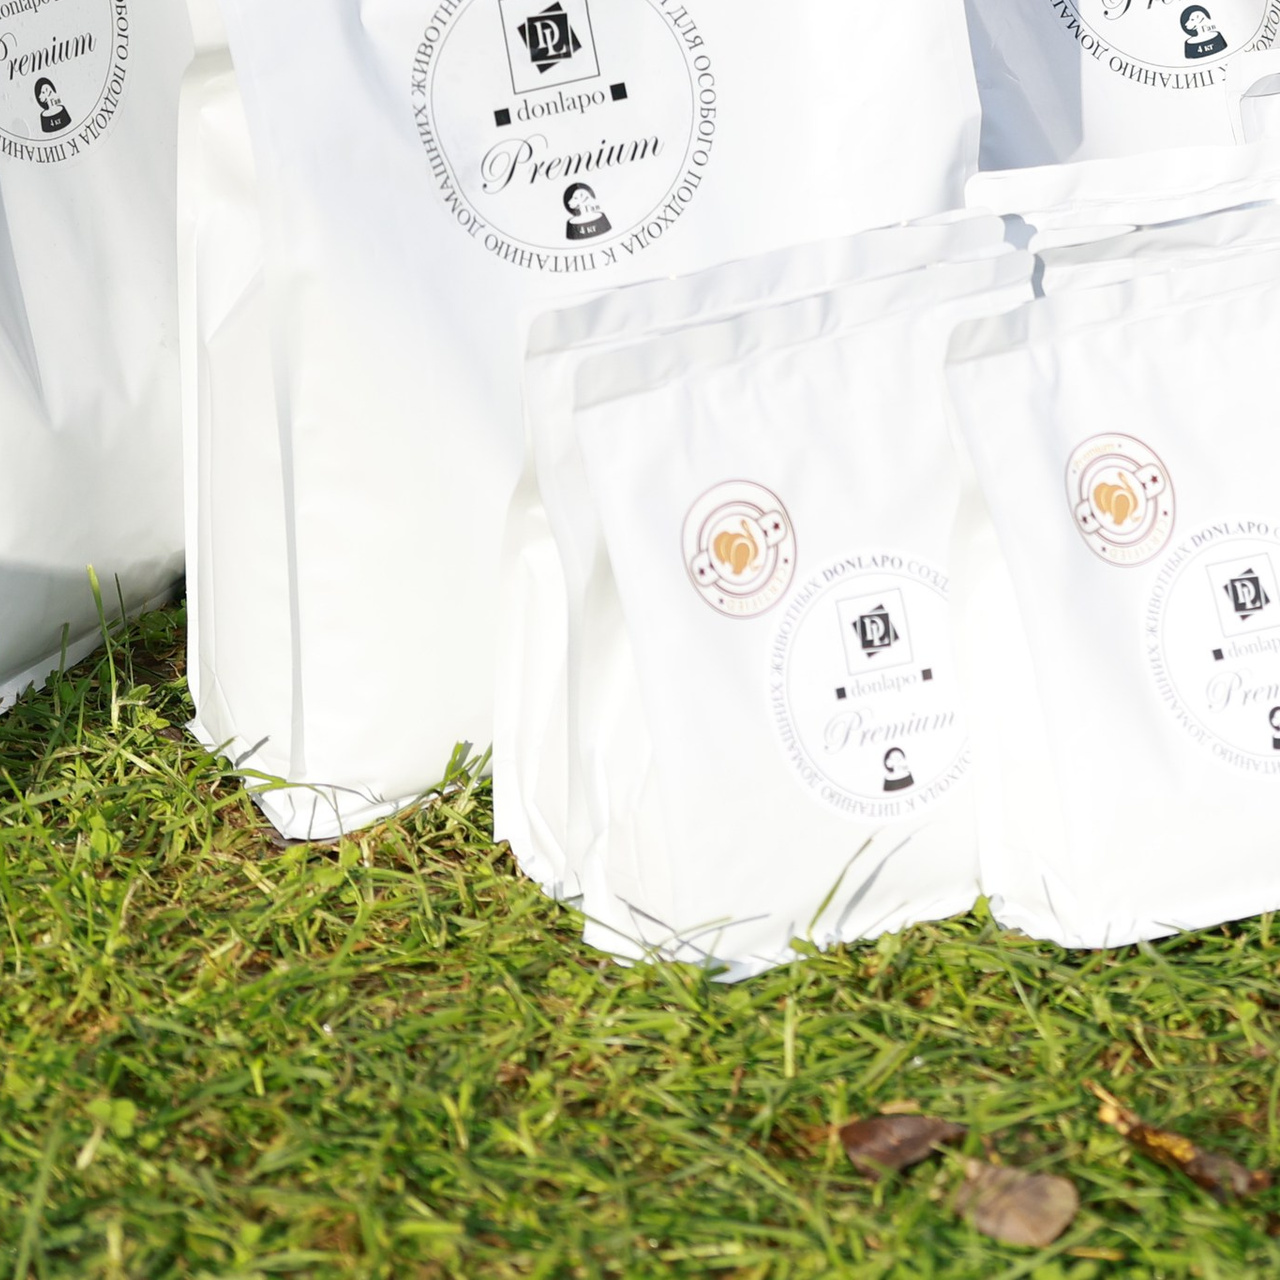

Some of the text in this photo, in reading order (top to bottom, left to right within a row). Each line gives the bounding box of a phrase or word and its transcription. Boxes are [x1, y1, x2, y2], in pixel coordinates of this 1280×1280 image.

[665, 4, 705, 52] ДЛЯ
[1197, 42, 1215, 54] 4 кг
[1109, 56, 1215, 90] ПИТАНИЮ
[78, 60, 127, 145] ПОДХОДА
[516, 88, 605, 123] donlapo
[693, 55, 718, 168] ОСОБОГО
[0, 132, 67, 164] ПИТАНИ
[481, 133, 665, 195] Premium
[412, 104, 486, 237] ДОМАШНИХ
[621, 171, 703, 258] ПОДХОДА
[483, 233, 597, 274] ПИТАНИЮ
[821, 554, 903, 583] DONLAPO
[851, 670, 918, 699] donlapo
[823, 707, 955, 755] Premium
